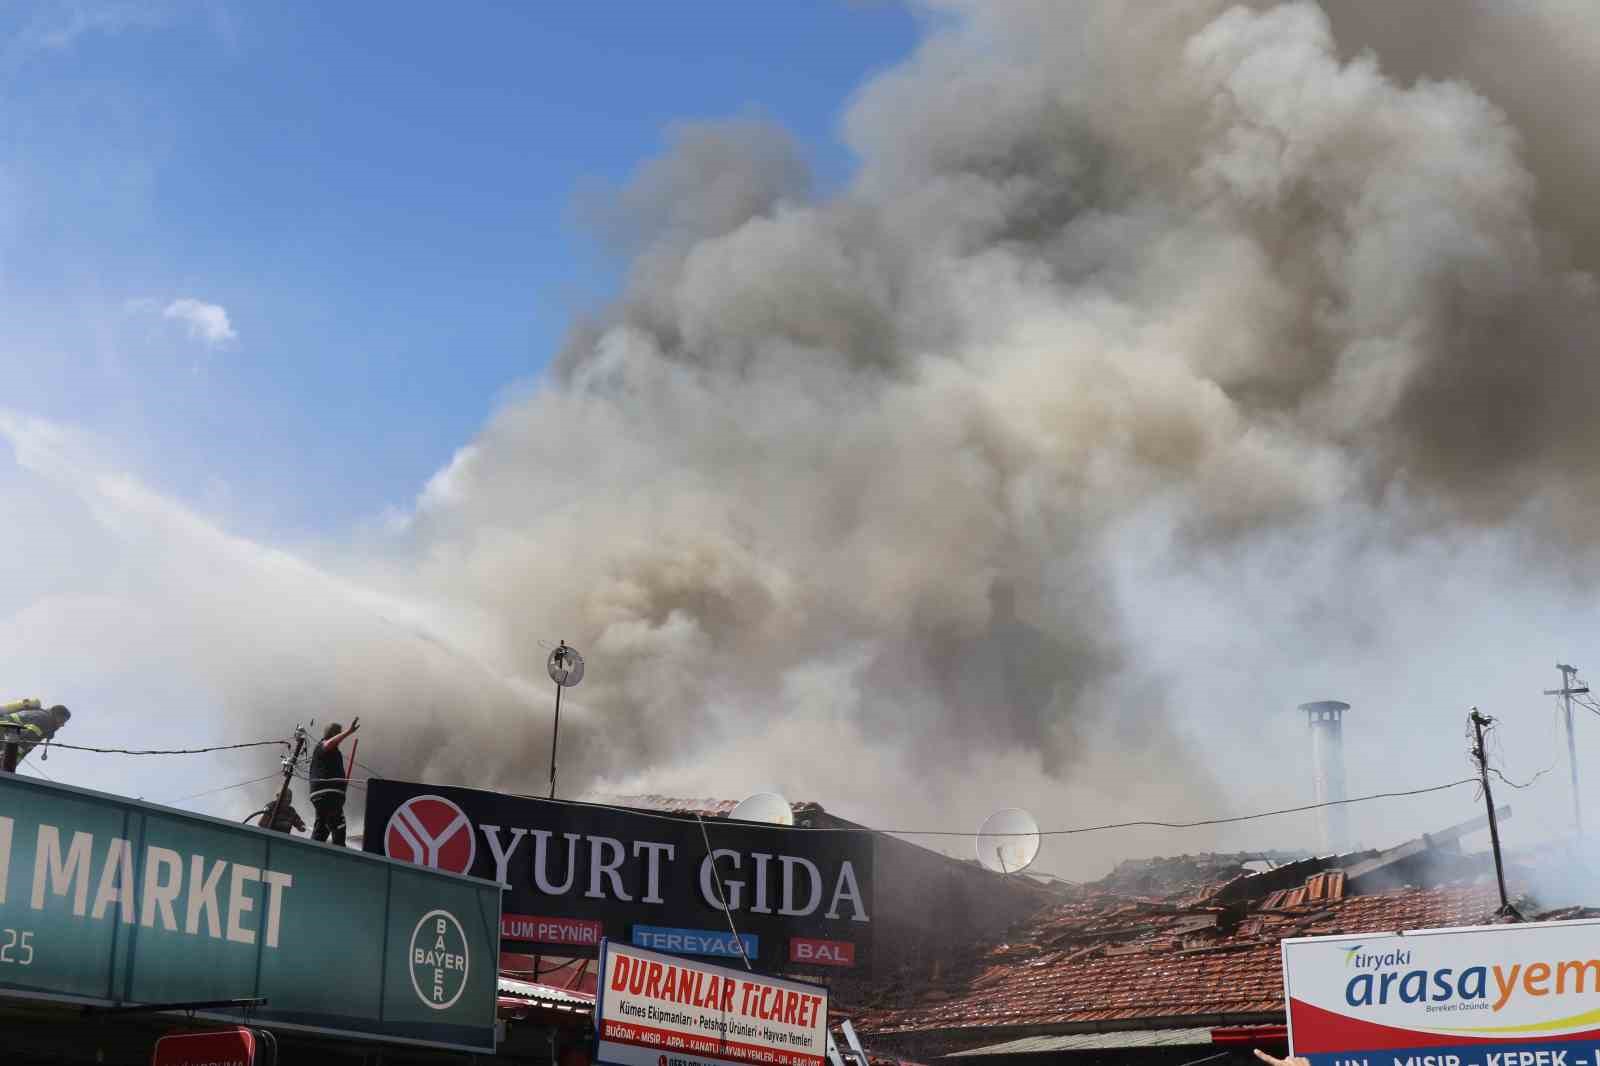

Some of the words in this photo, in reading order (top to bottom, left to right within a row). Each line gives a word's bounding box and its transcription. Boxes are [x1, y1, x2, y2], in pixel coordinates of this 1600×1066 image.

[479, 824, 675, 905] YURT
[699, 848, 870, 923] GIDA
[31, 823, 293, 949] MARKET
[538, 922, 599, 945] PEYNİRİ
[415, 947, 465, 971] BAYER
[797, 943, 850, 962] BAL
[1354, 949, 1411, 971] tiryaki
[611, 954, 736, 1012] DURANLAR
[619, 1000, 648, 1018] Kümes
[648, 1004, 693, 1027] Ekipmanları
[699, 1014, 728, 1033] Petshop
[763, 1026, 788, 1043] Hayvan
[789, 1031, 814, 1048] Yemleri
[1486, 1050, 1569, 1066] KEPEK
